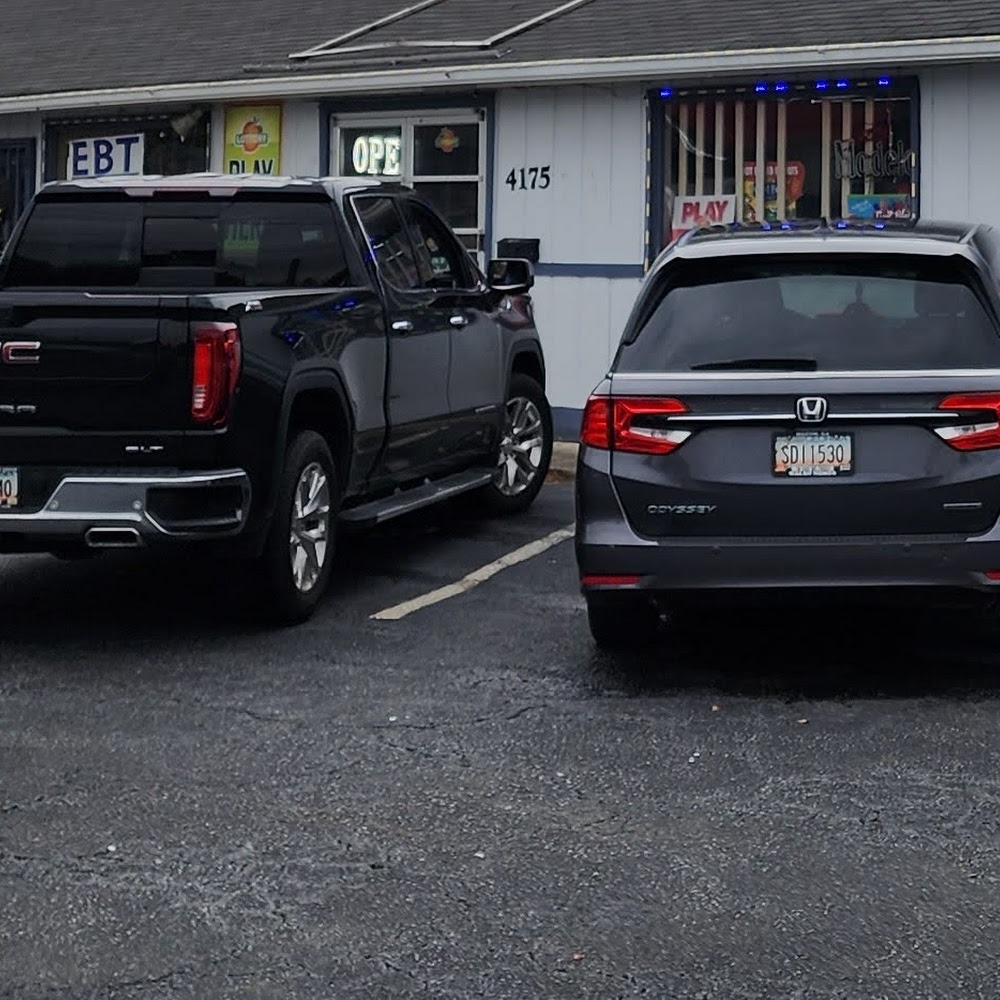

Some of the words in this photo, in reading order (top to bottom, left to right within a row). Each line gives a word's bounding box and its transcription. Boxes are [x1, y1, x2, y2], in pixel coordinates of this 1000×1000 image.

[72, 136, 139, 176] EBT
[506, 166, 550, 190] 4175
[682, 200, 728, 223] PLAY
[0, 341, 41, 364] C
[647, 504, 718, 514] ODYSSEY
